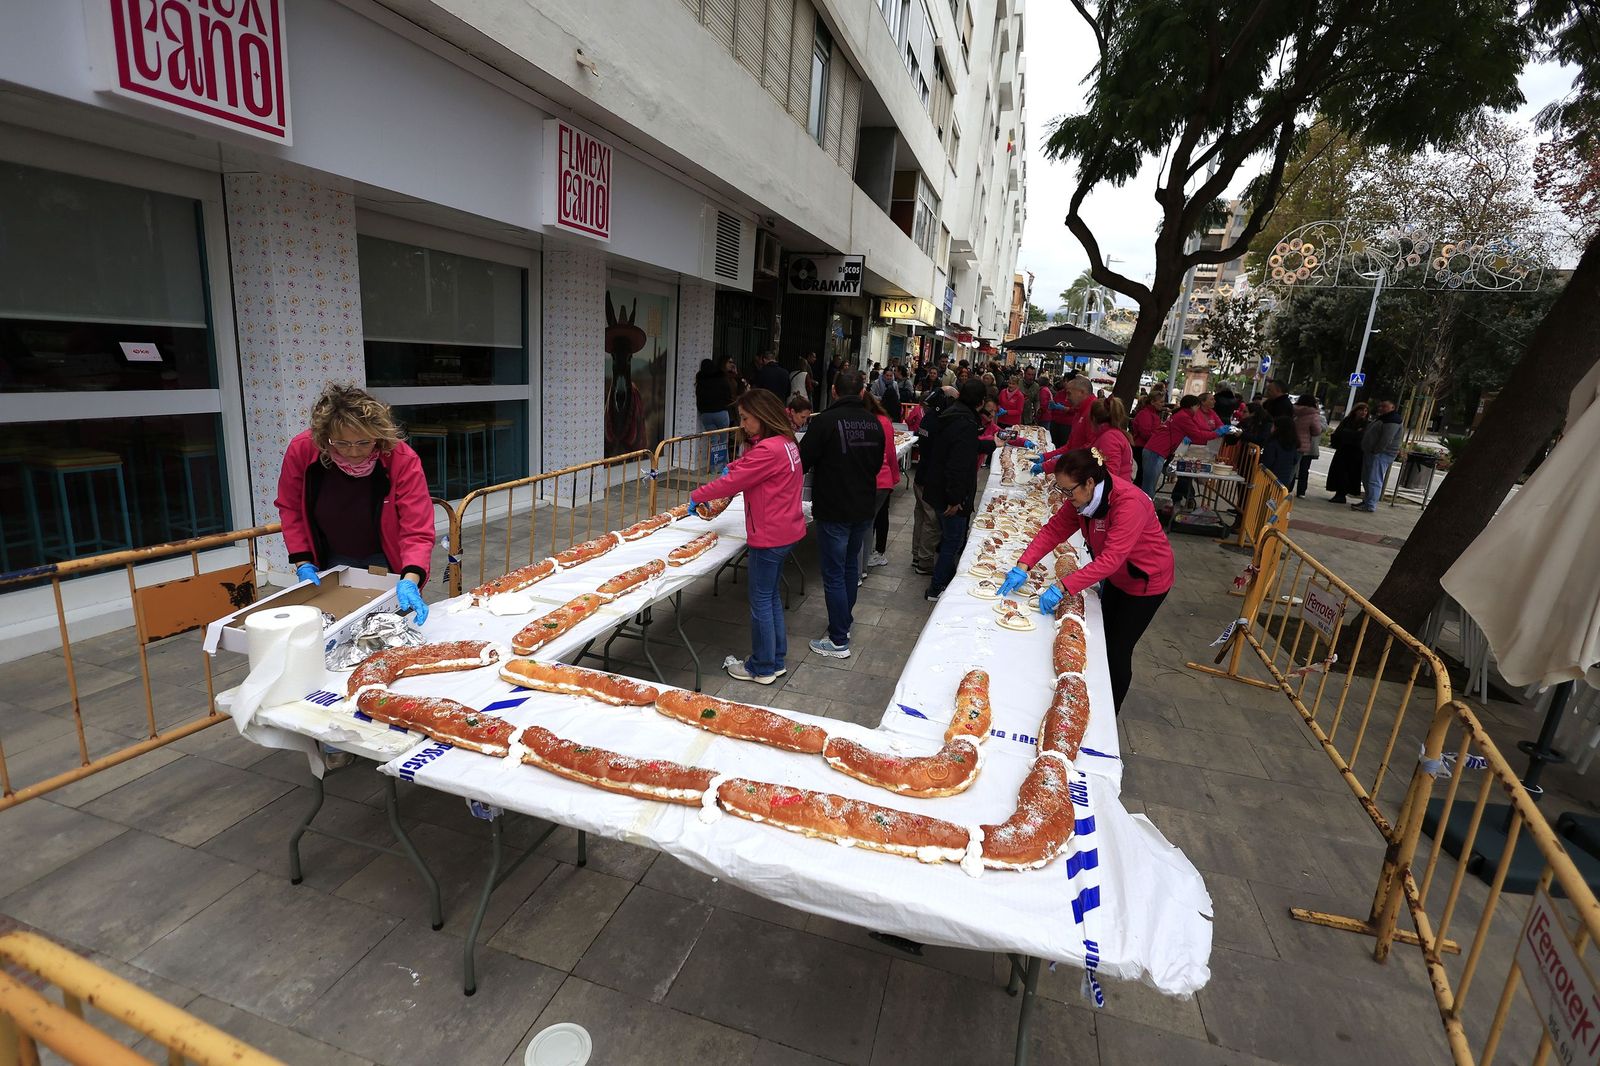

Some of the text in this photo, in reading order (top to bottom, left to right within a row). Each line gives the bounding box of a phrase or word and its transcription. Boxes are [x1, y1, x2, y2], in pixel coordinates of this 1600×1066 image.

[563, 169, 606, 230] cano
[838, 266, 860, 275] DISCOS
[803, 279, 859, 293] GRAMMY
[884, 302, 917, 314] RIOS
[843, 420, 878, 431] bandera
[846, 430, 865, 440] rosa
[1308, 592, 1337, 623] Ferrotek
[1533, 911, 1595, 1046] Ferrotek
